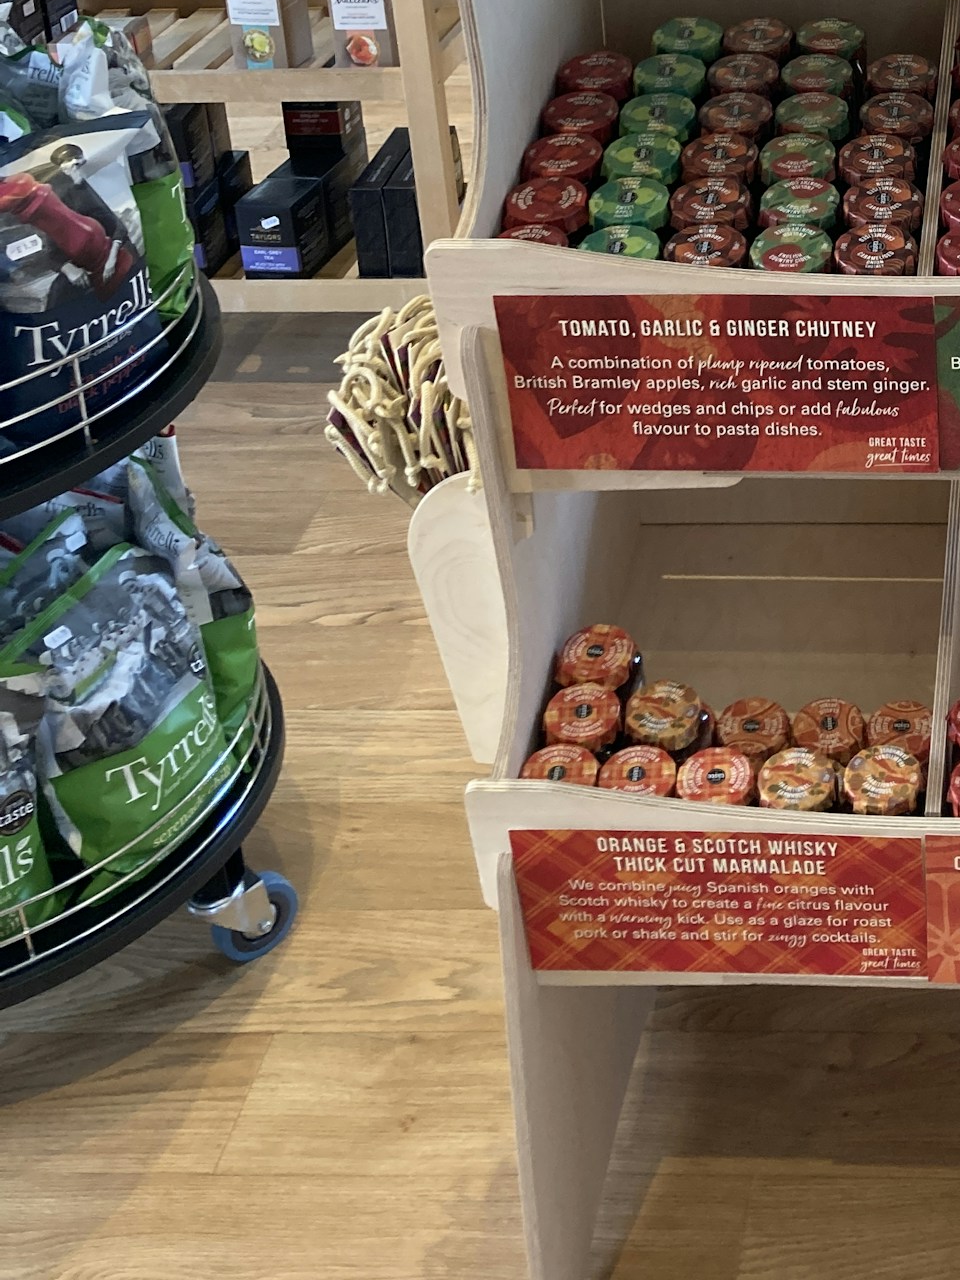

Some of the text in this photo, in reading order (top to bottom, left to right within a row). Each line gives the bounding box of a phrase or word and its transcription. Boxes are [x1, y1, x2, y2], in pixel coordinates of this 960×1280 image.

[559, 320, 877, 339] TOMATO, GARLIC & GINGER CHUTNEY
[551, 356, 890, 376] A combination of plump ripened tomatoes,
[868, 438, 926, 447] GREAT TASTE
[865, 449, 931, 468] great times
[597, 838, 839, 857] ORANGE & SCOTCH WHISKY
[613, 857, 826, 875] THICK CUT MARMALADE
[568, 879, 594, 891] We
[599, 880, 662, 893] combine
[707, 881, 768, 896] Spanish
[774, 884, 836, 896] oranges
[841, 884, 874, 895] with
